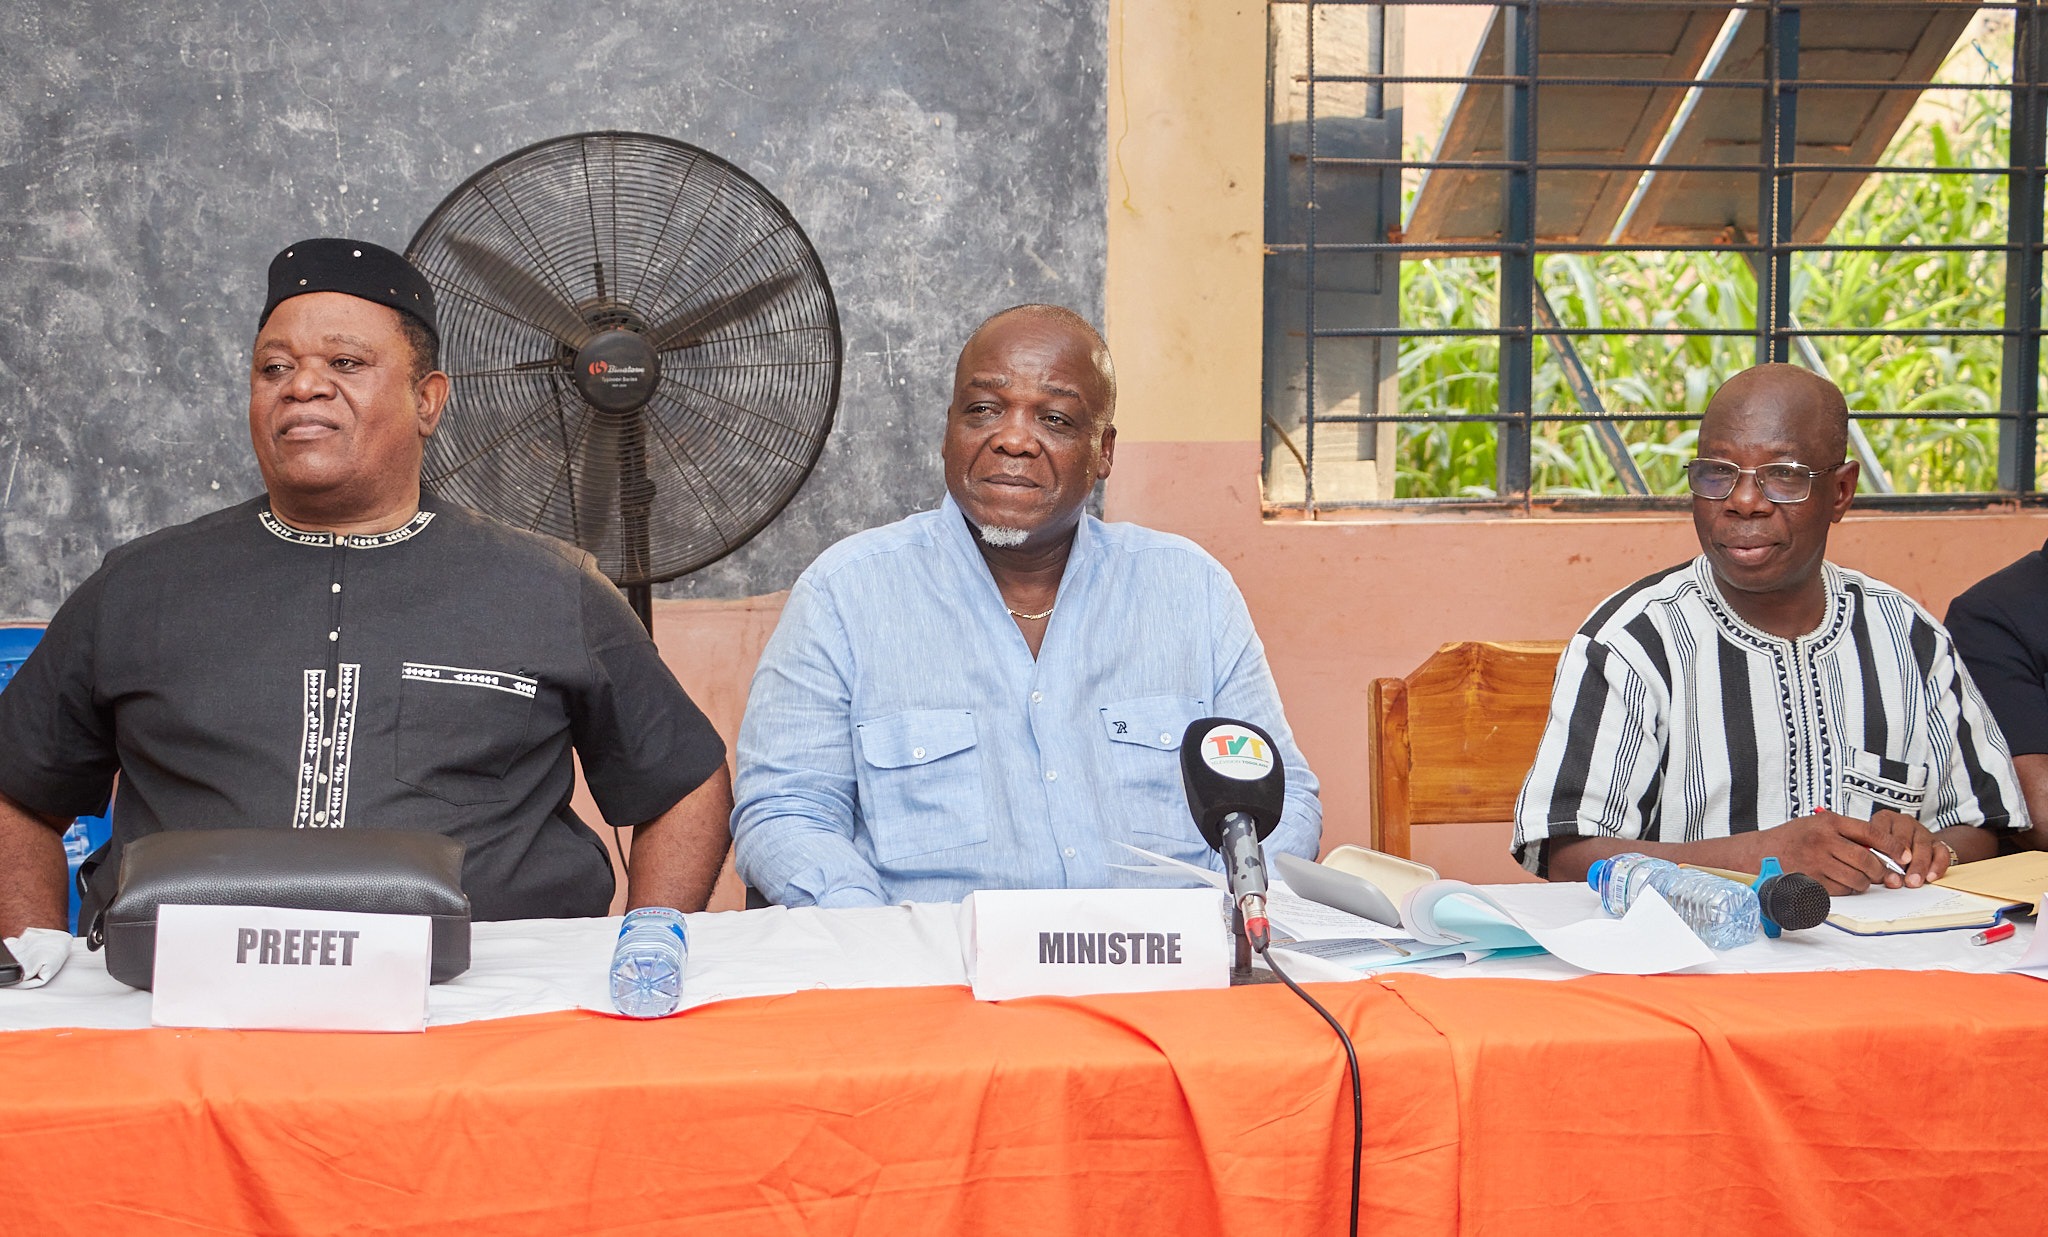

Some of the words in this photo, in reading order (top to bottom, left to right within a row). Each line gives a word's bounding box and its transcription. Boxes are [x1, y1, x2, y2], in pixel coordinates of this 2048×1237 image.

[1208, 735, 1265, 758] TVT
[236, 928, 360, 966] PREFET
[1039, 932, 1182, 964] MINISTRE
